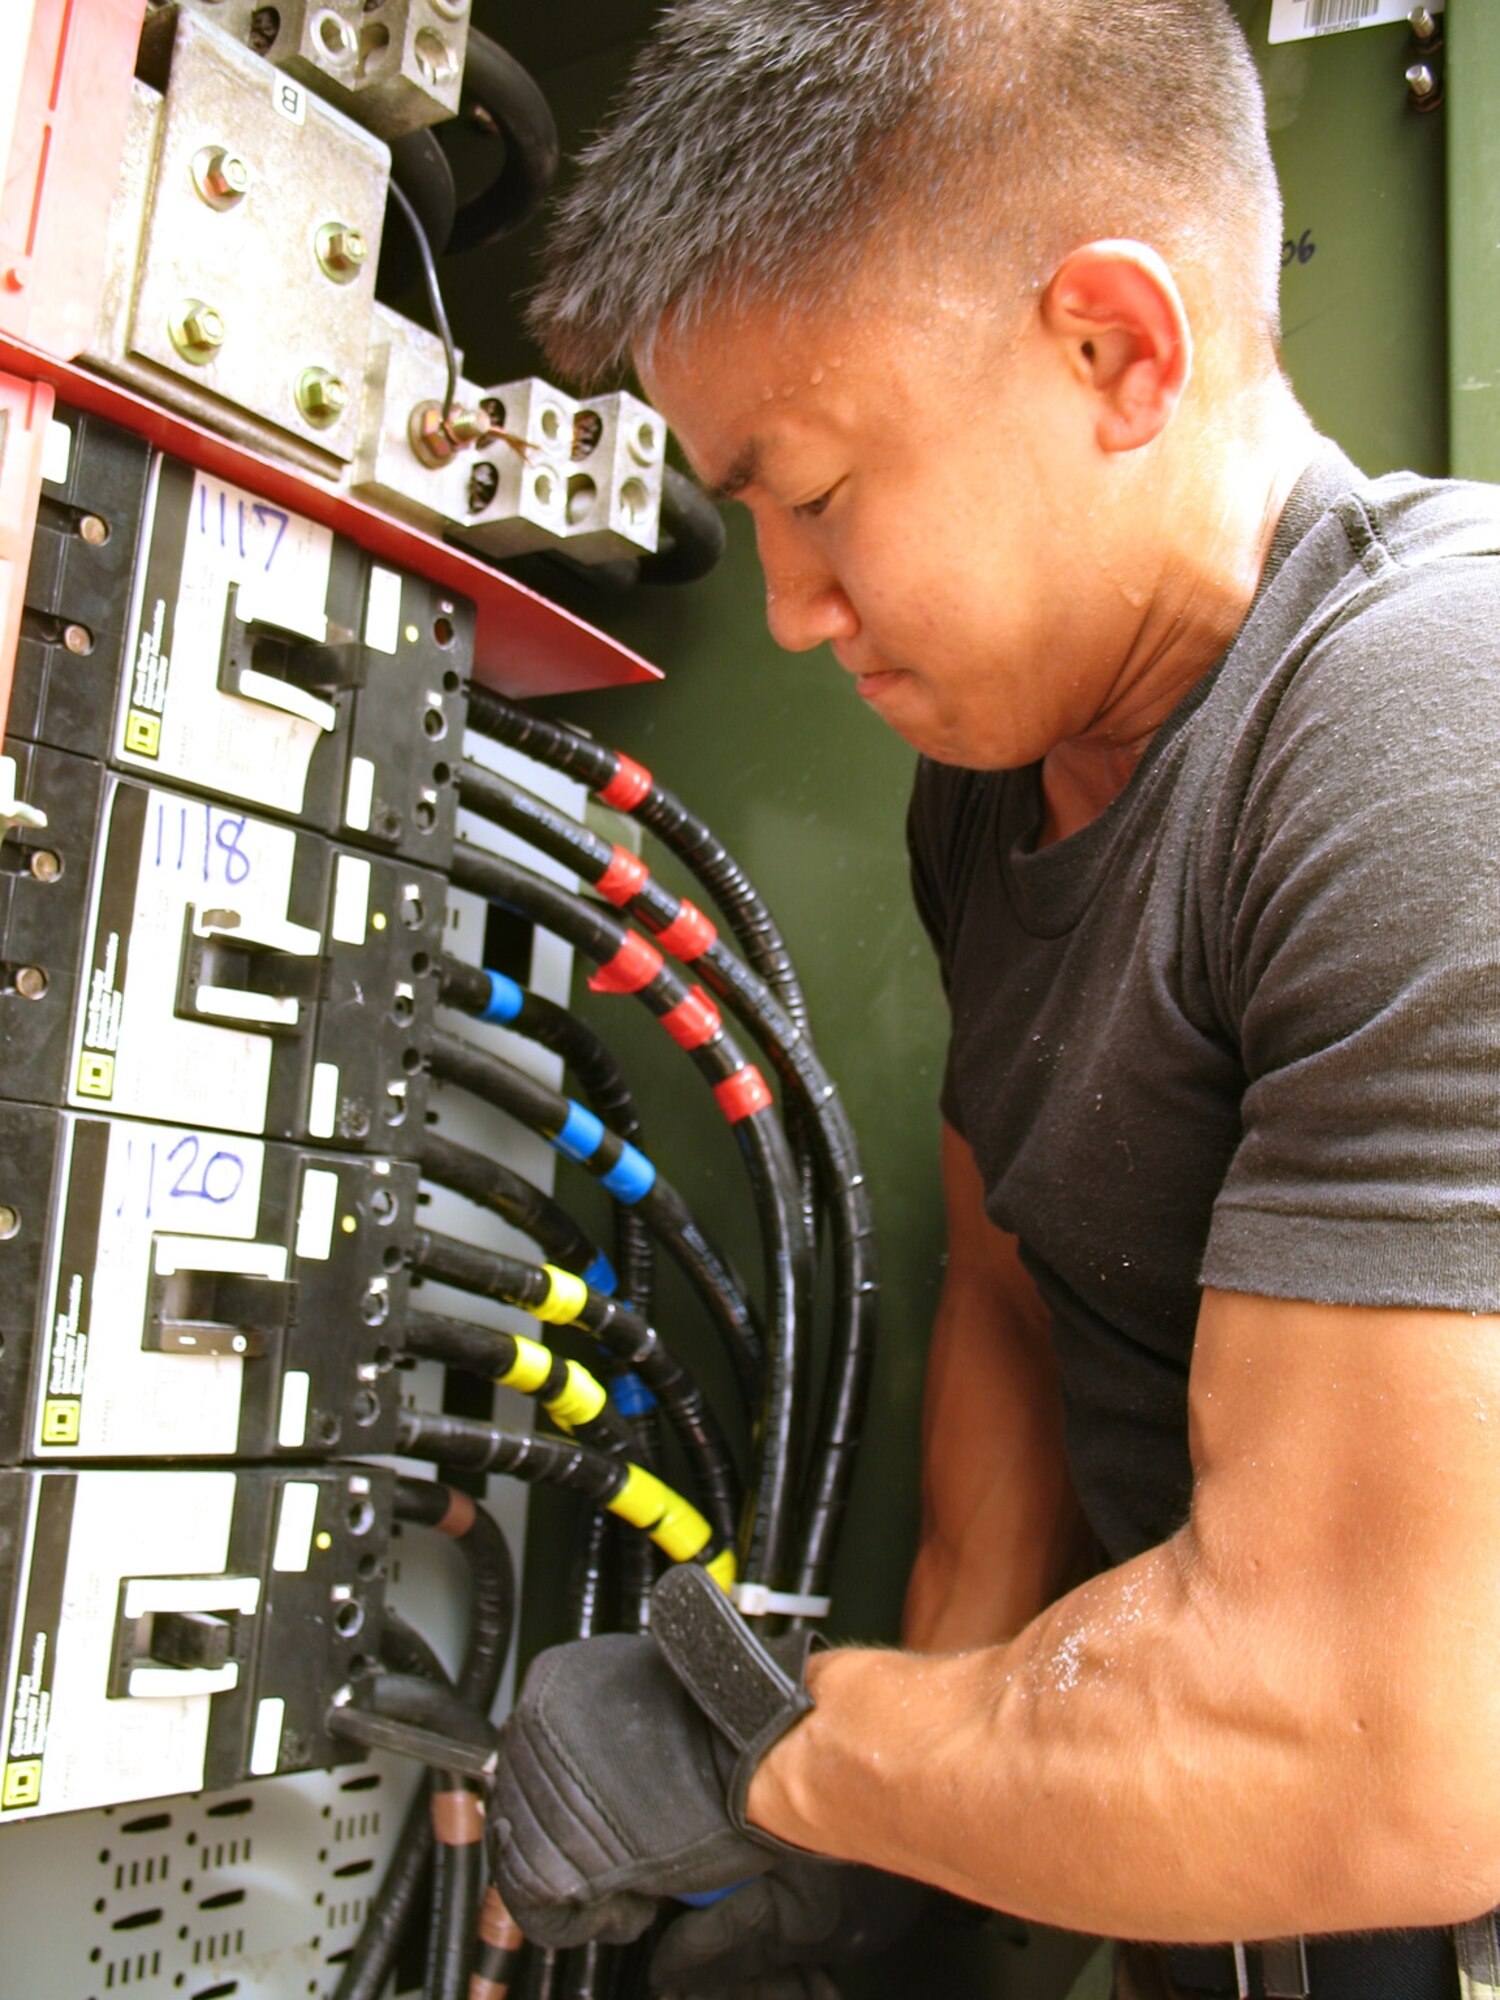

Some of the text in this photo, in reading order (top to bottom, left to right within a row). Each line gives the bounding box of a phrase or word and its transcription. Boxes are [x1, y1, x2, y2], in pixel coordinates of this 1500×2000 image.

[281, 85, 298, 115] B
[200, 484, 289, 572] 1117
[155, 804, 250, 885] 1118
[116, 1135, 244, 1218] 1120
